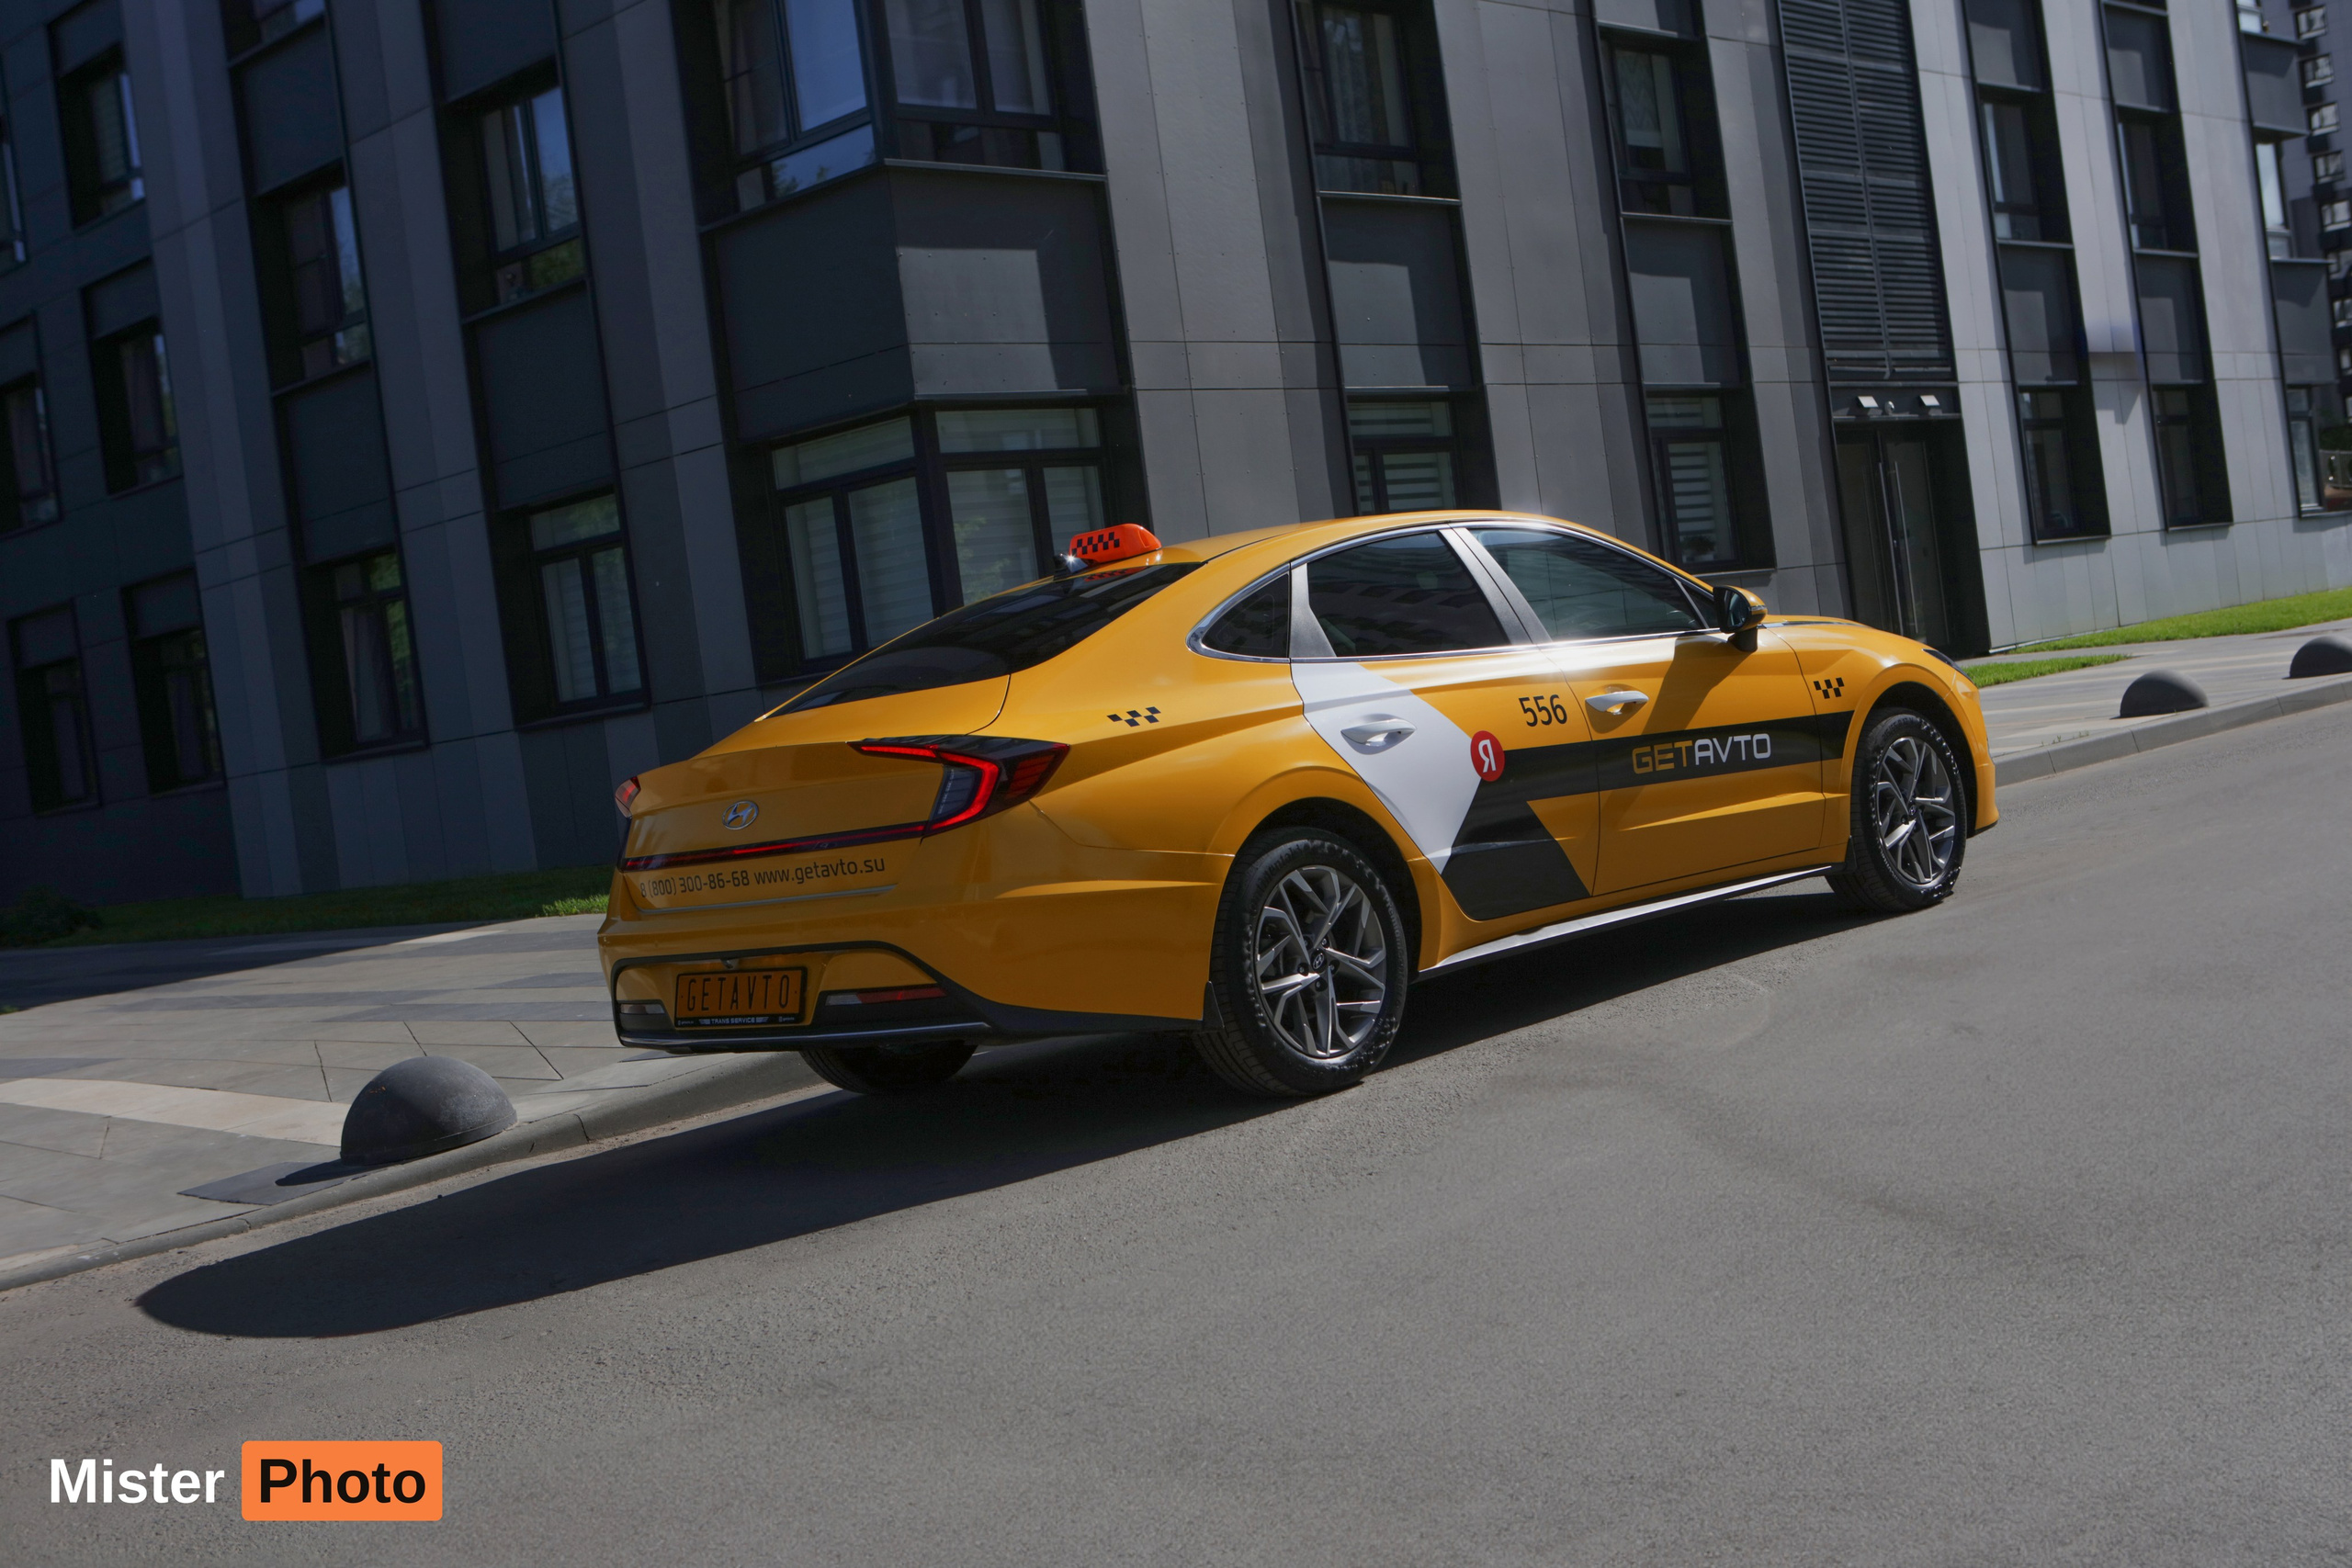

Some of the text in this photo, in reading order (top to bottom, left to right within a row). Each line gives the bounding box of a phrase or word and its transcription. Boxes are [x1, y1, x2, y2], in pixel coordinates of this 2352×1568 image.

[1518, 694, 1567, 727] 556
[1477, 739, 1497, 773] Я
[1632, 733, 1771, 774] GETAVTO
[639, 858, 885, 898] 8 (800) 300-86-68 www.getavto.su
[687, 975, 790, 1011] GETAVTO
